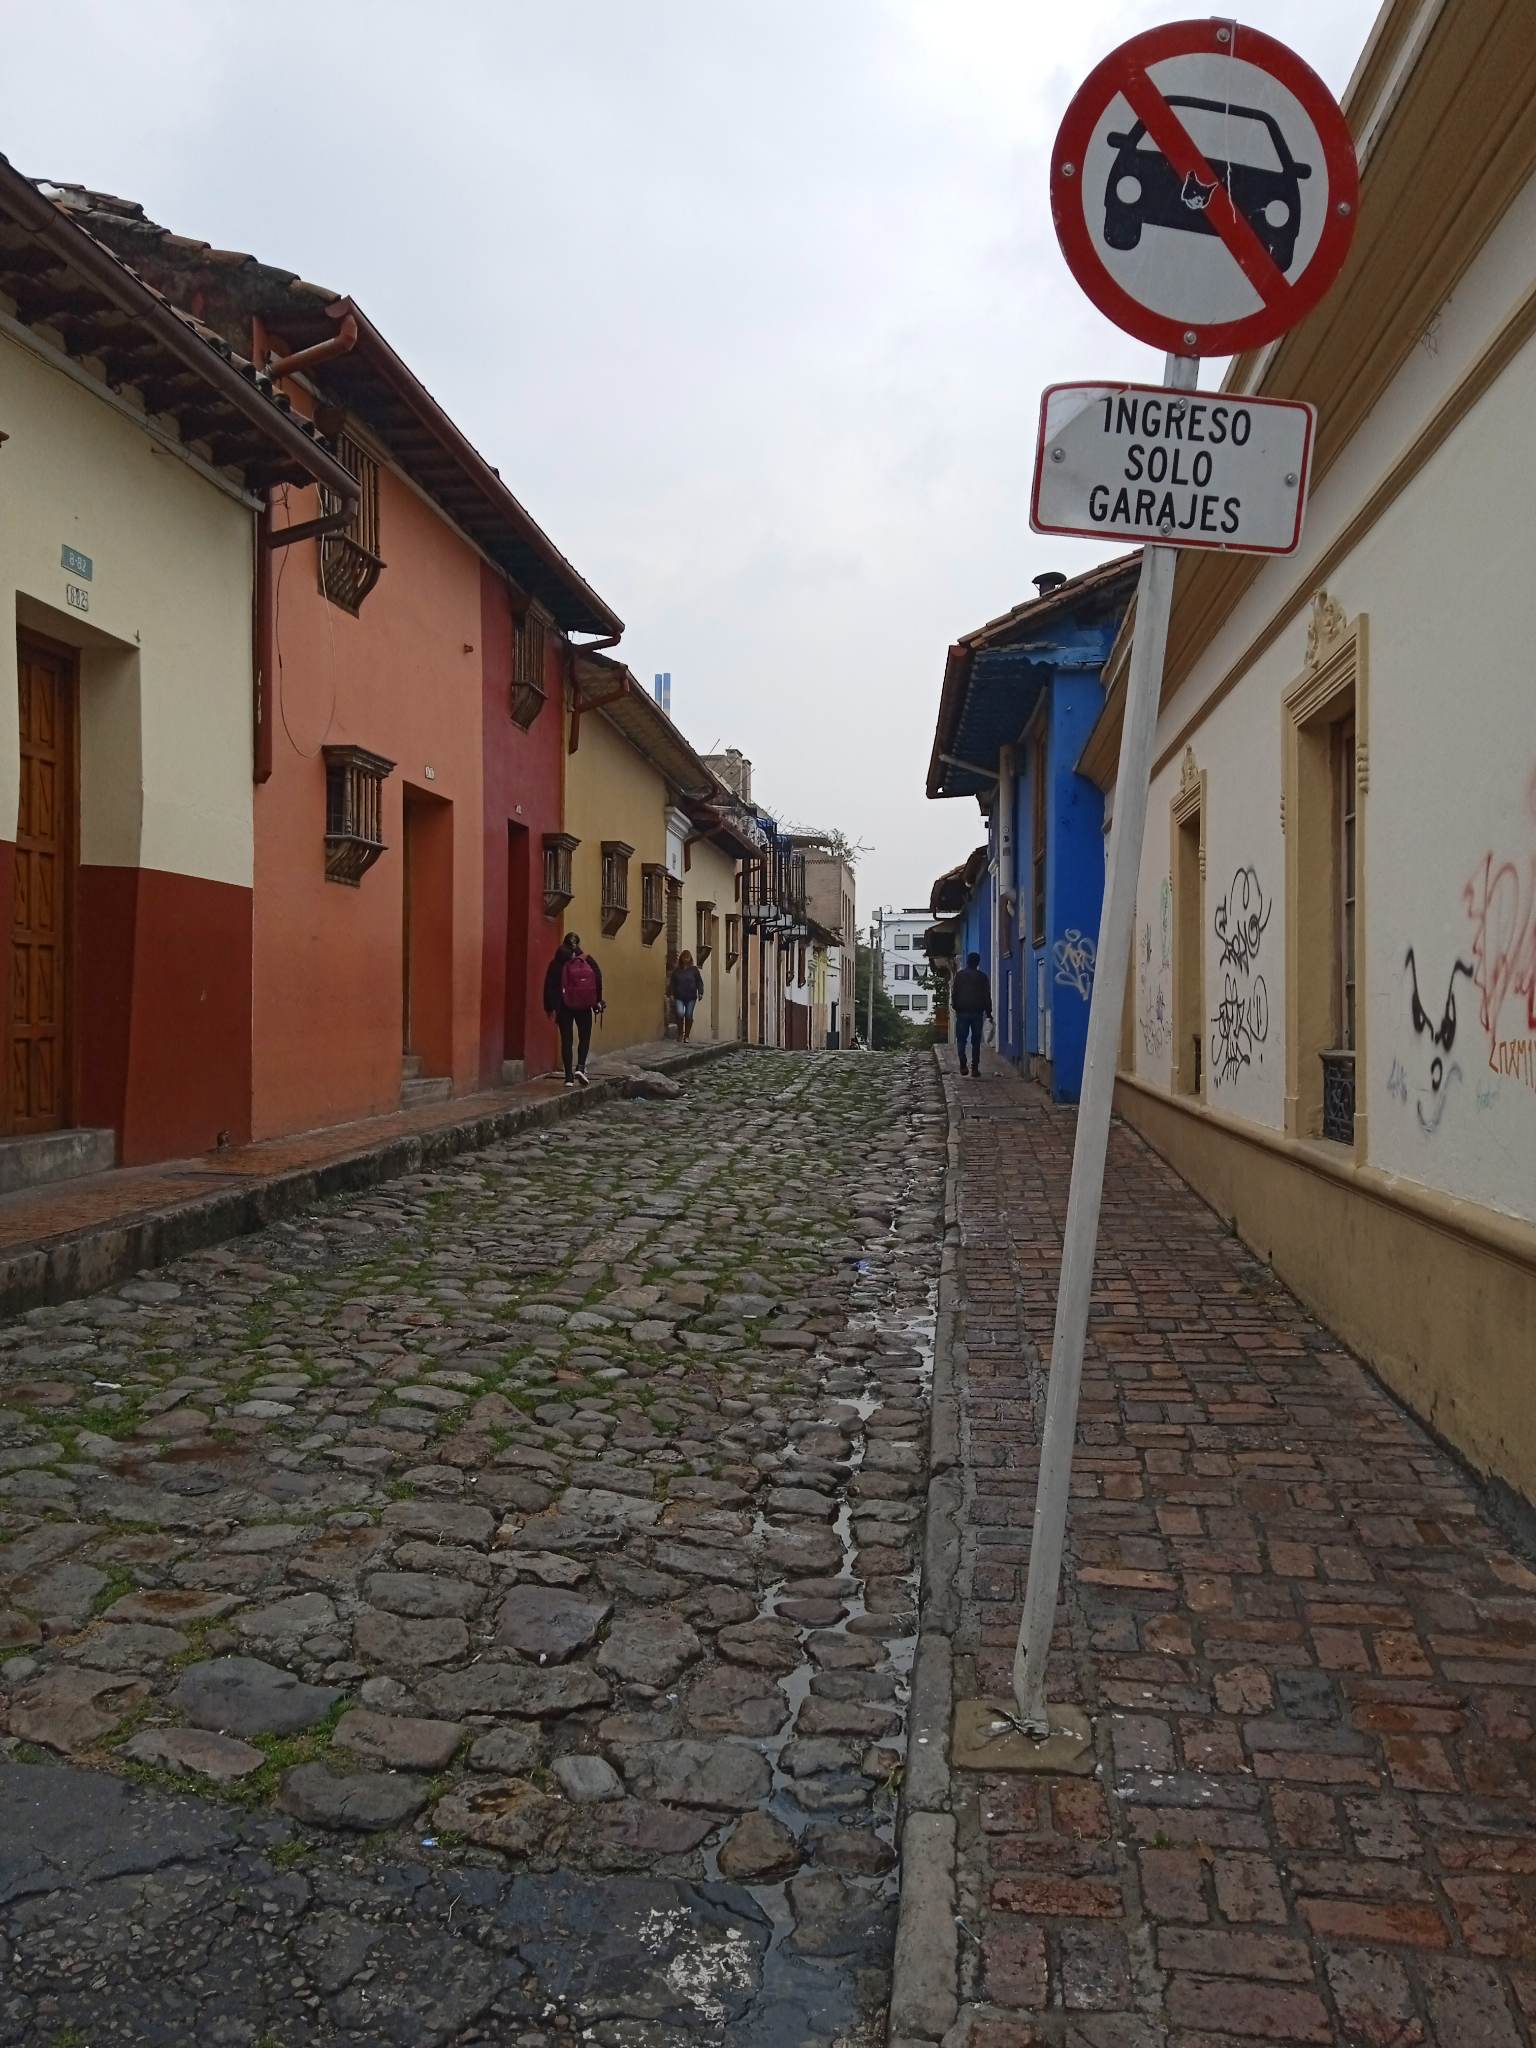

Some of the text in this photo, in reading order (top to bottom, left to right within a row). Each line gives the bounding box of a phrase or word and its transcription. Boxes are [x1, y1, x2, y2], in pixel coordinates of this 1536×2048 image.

[1103, 396, 1251, 446] INGRESO
[1124, 444, 1213, 487] SOLO
[1089, 485, 1241, 534] GARAJES
